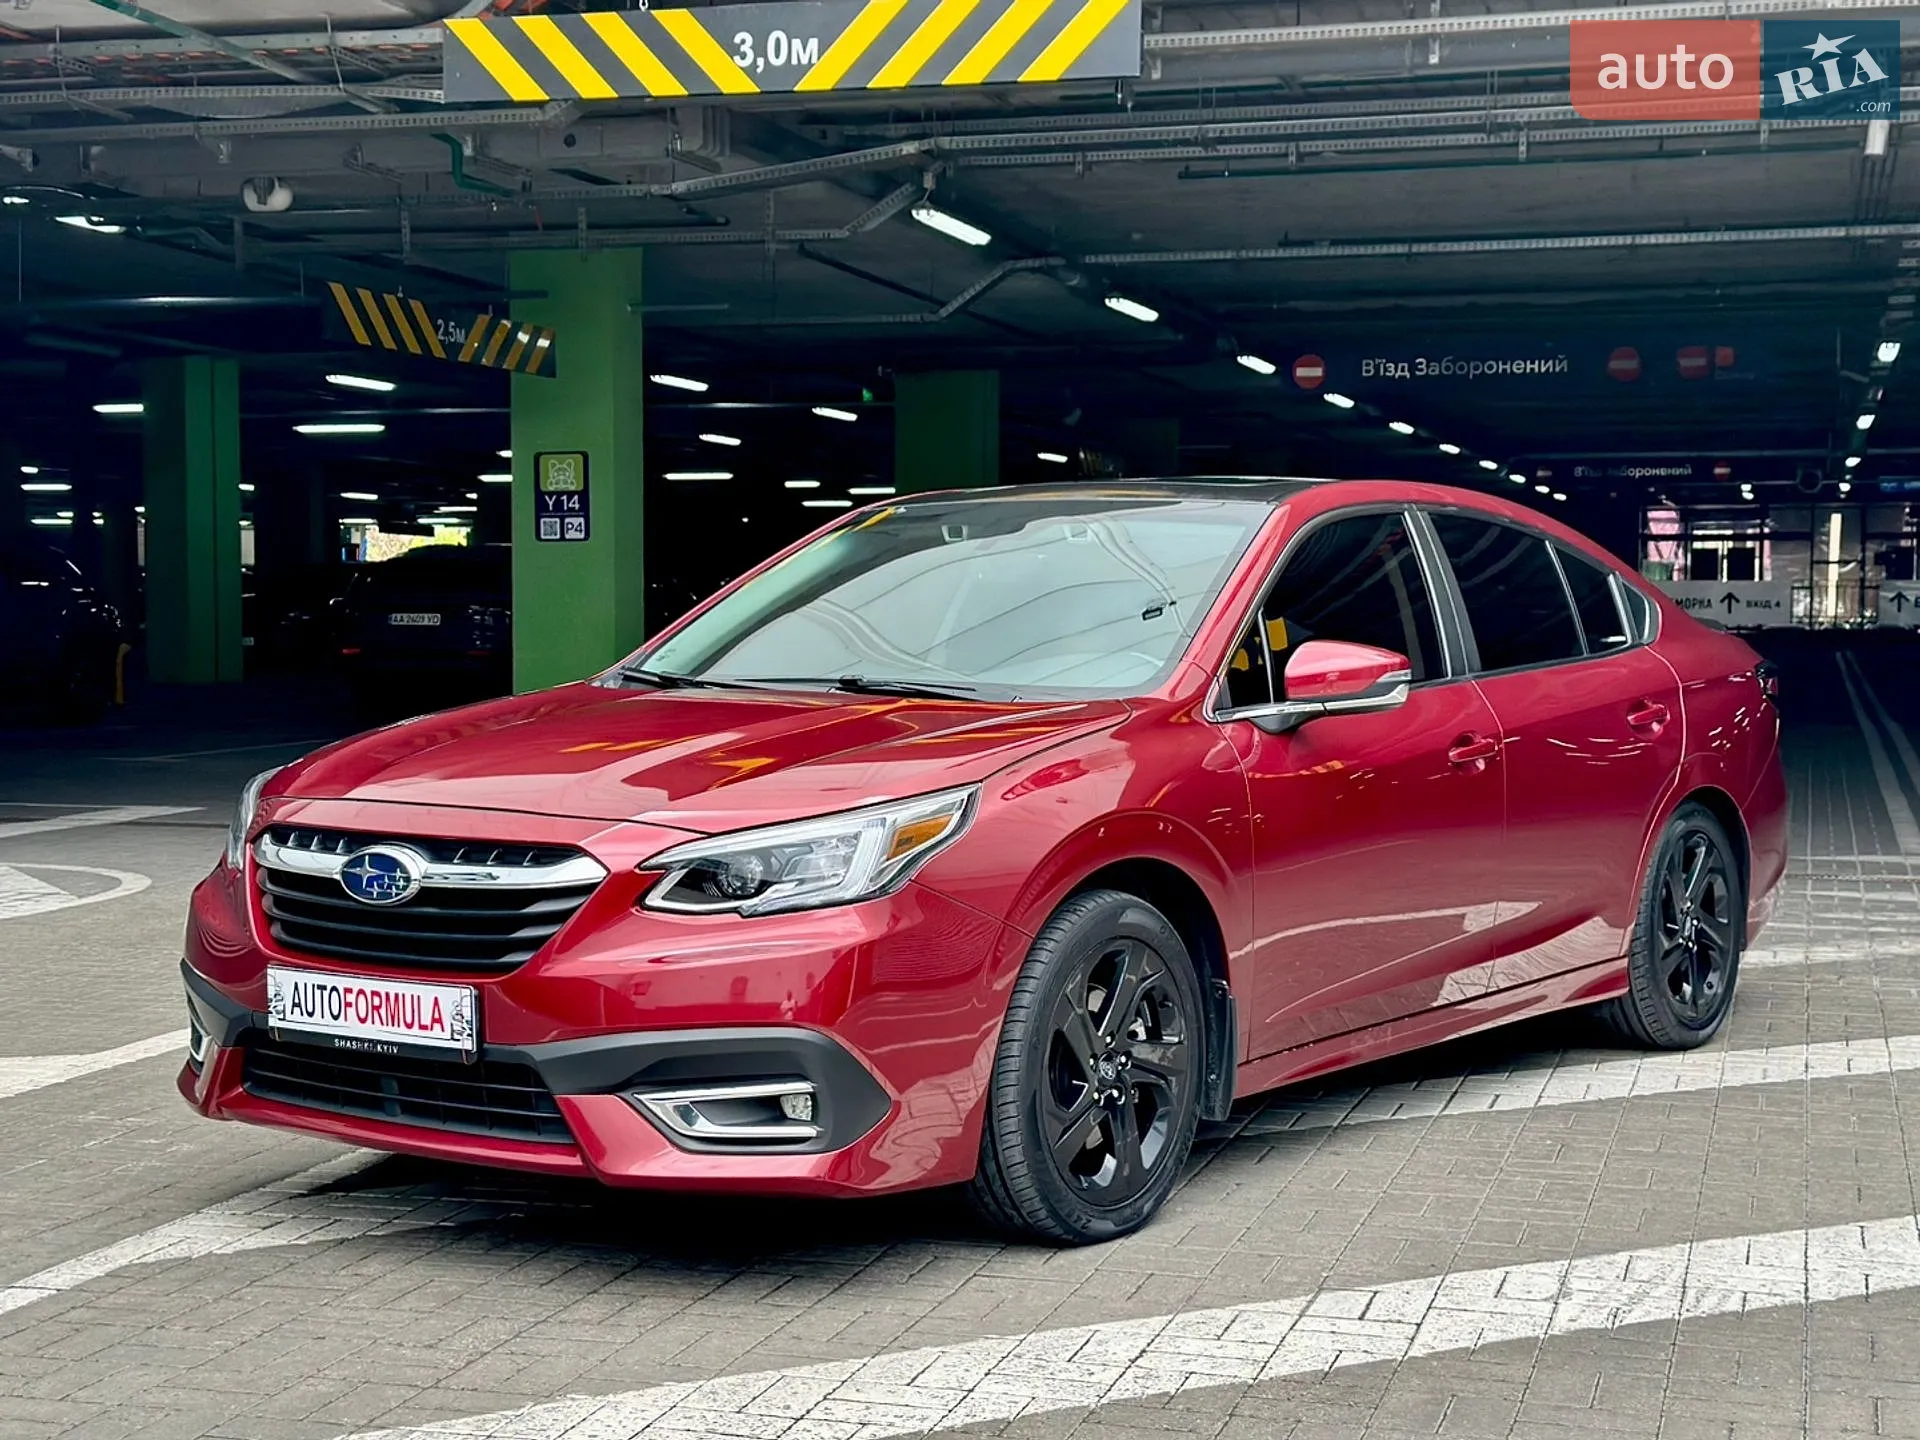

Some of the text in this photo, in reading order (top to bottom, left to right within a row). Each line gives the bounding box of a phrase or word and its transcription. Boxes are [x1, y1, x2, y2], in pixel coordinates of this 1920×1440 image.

[1415, 354, 1569, 380] Заборонений
[543, 494, 581, 511] Y 14
[565, 521, 583, 535] P4
[290, 980, 446, 1033] AUTOFORMULA
